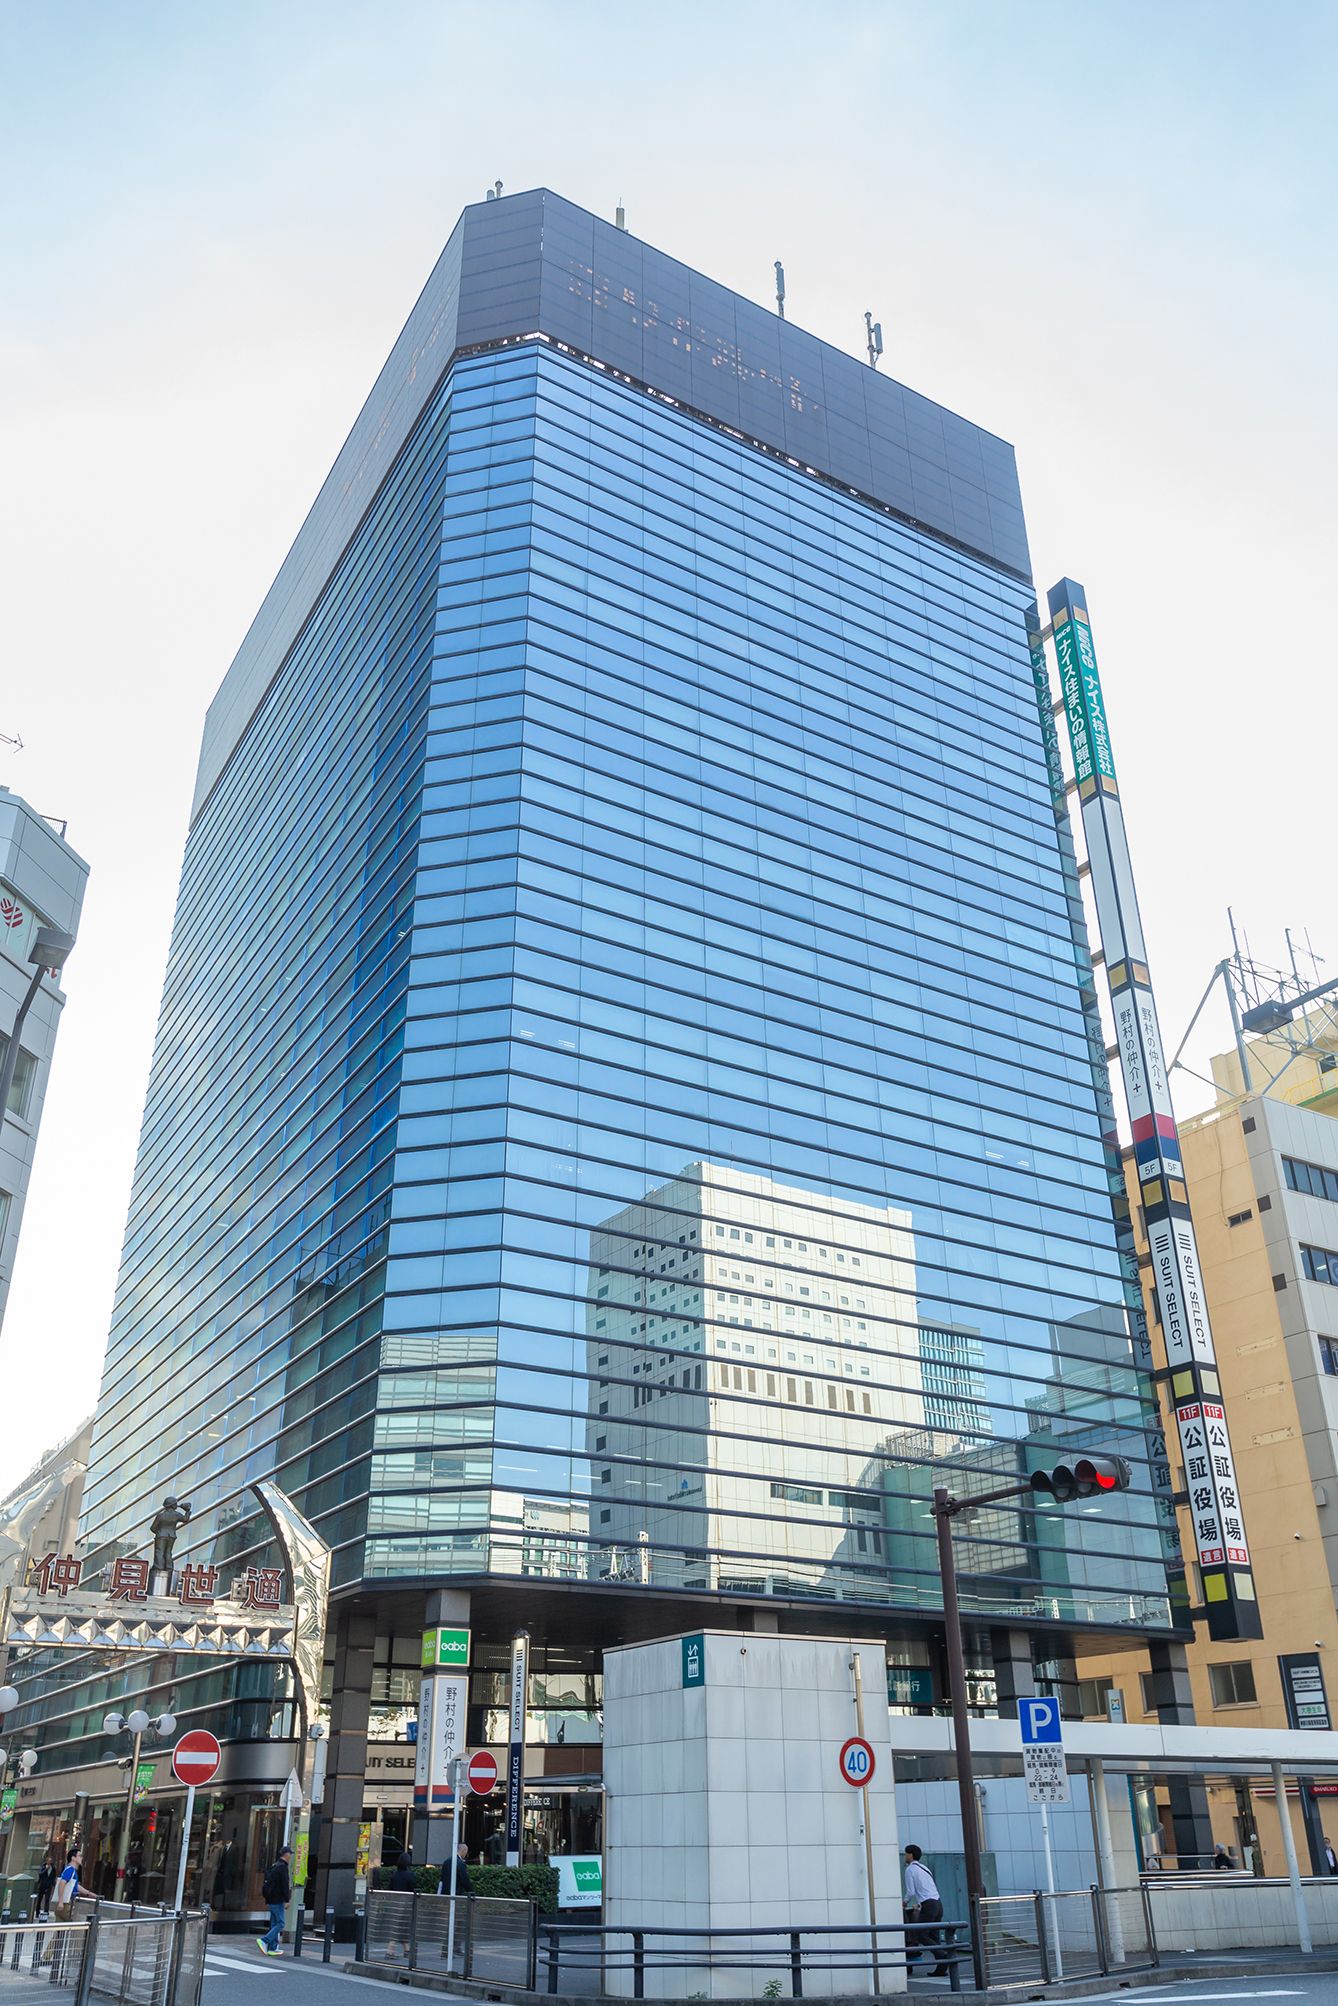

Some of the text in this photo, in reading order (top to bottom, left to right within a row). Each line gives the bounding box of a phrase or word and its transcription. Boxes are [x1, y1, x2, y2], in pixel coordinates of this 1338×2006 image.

[1058, 639, 1093, 781] ナイス住まいの情報館
[1084, 675, 1114, 776] ナイス株式会社
[1144, 1163, 1156, 1176] 5F
[1167, 1162, 1177, 1172] 5F
[1160, 1256, 1184, 1349] SUIT SELECT
[1183, 1254, 1207, 1348] SUIT SELECT
[1181, 1406, 1198, 1420] 11F
[1205, 1405, 1221, 1418] 11F
[1184, 1425, 1218, 1541] 公証役場
[1209, 1425, 1242, 1541] 公証役場
[33, 1552, 282, 1611] 仲見世通
[1029, 1703, 1052, 1739] P
[510, 1756, 519, 1838] DIFFERENCE
[847, 1751, 867, 1773] 40
